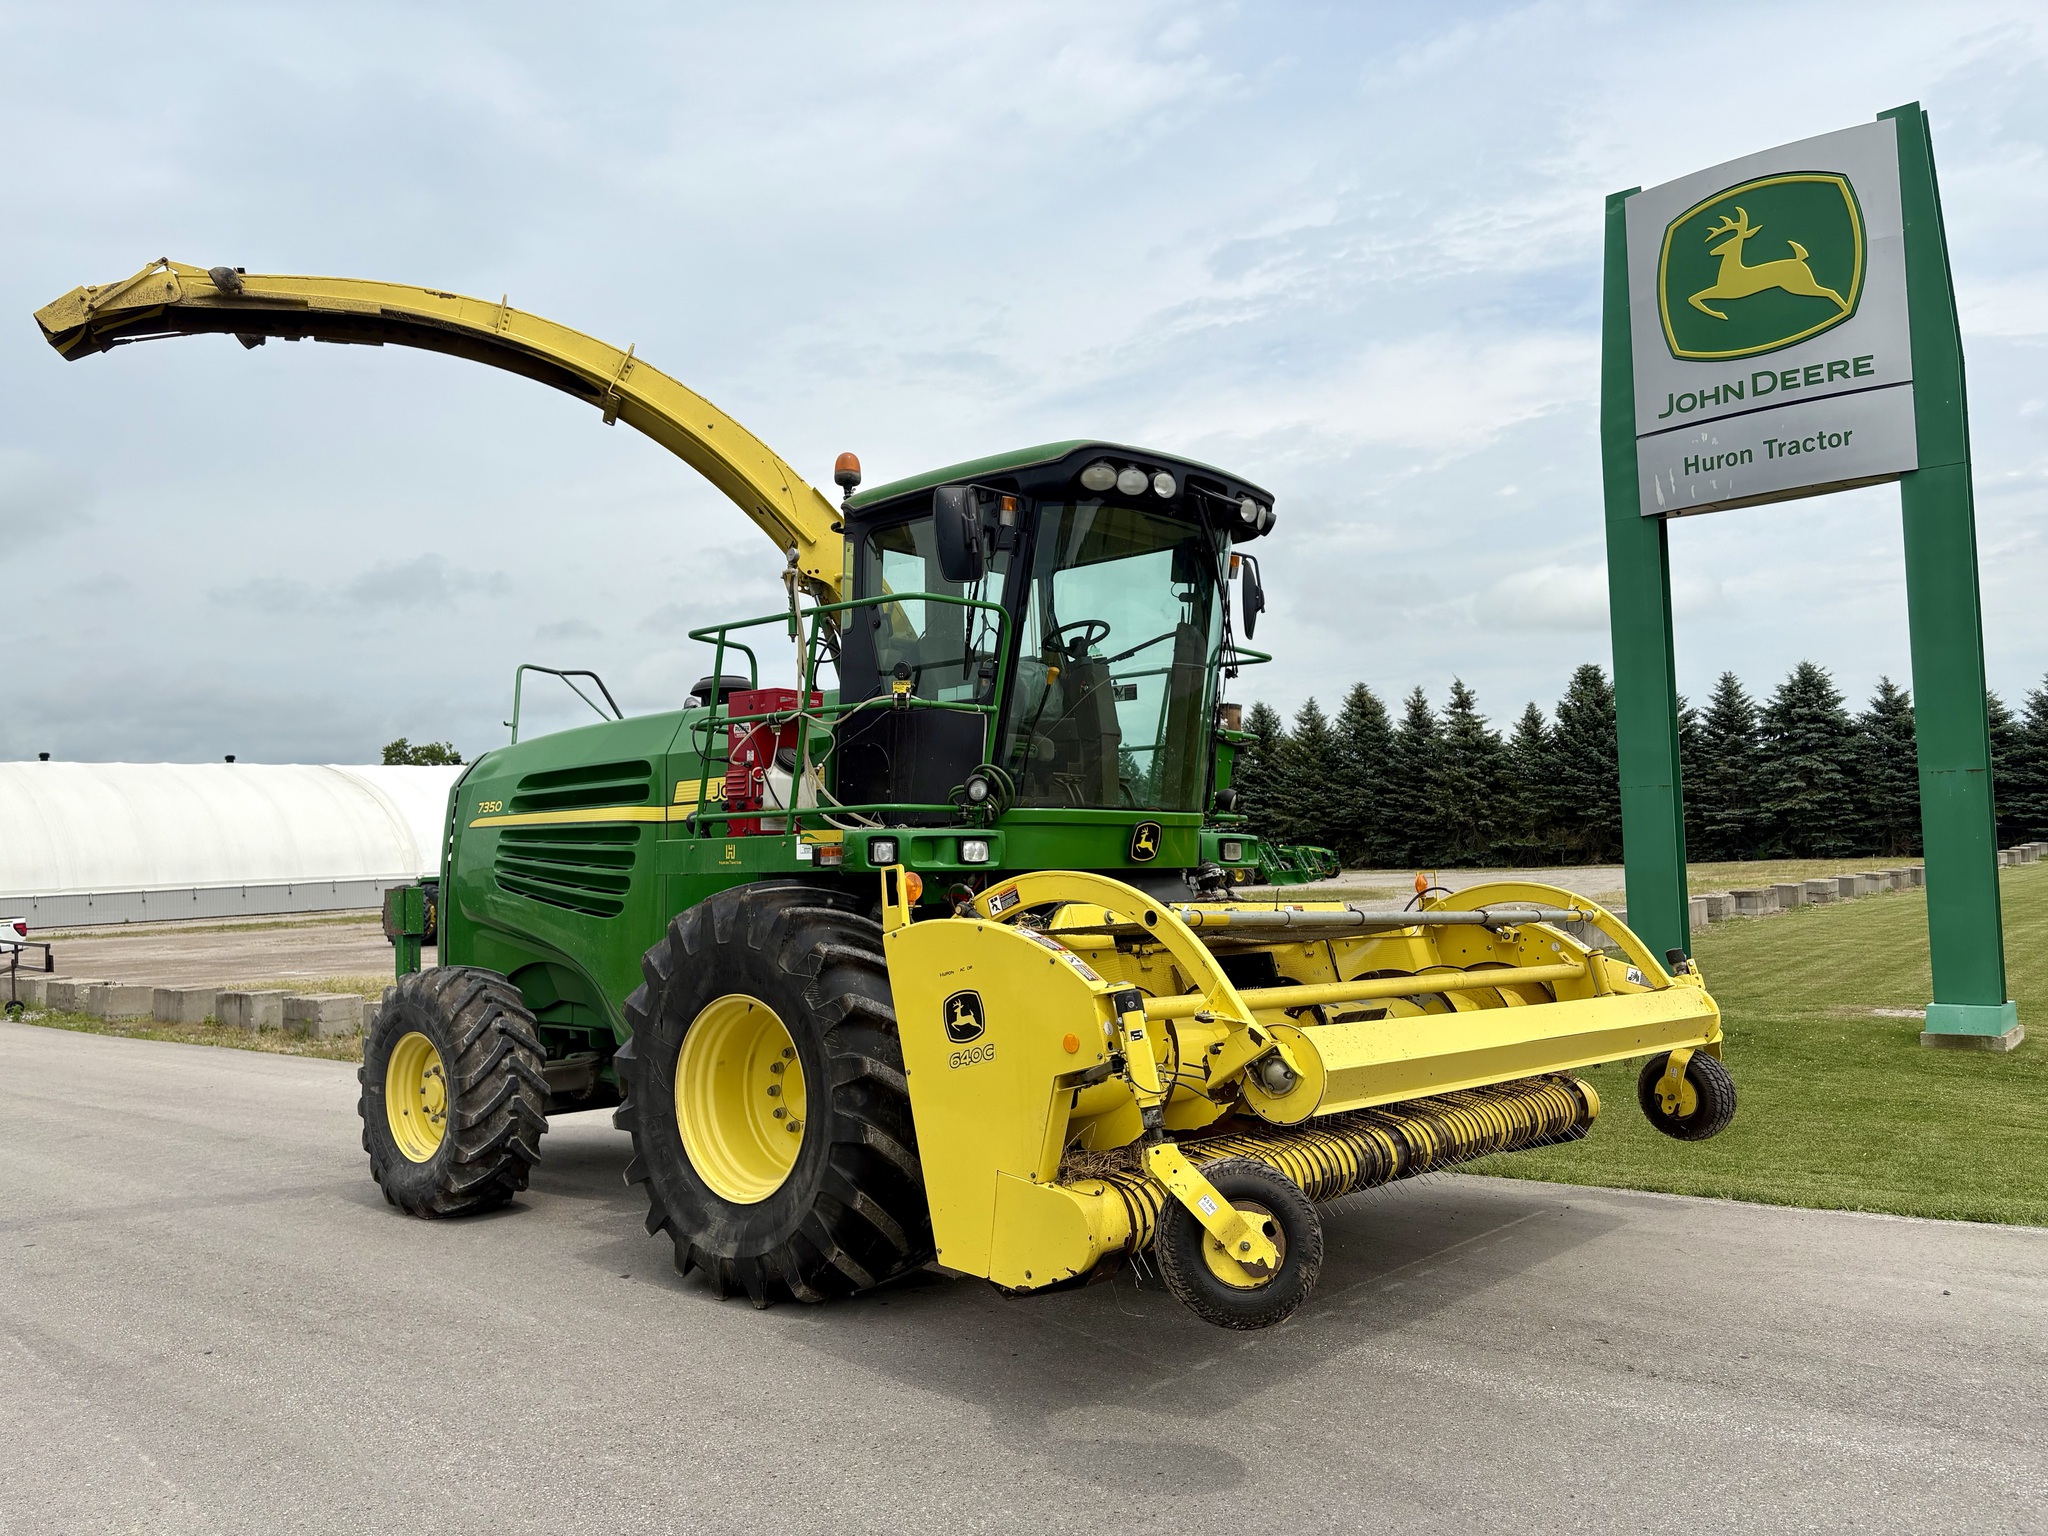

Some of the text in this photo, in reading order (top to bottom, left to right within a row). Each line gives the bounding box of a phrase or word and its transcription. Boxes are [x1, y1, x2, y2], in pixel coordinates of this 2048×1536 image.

[1658, 354, 1875, 419] JOHN DEERE
[1683, 430, 1853, 476] Huron Tractor
[477, 800, 503, 814] 7350
[949, 1043, 995, 1069] 640C
